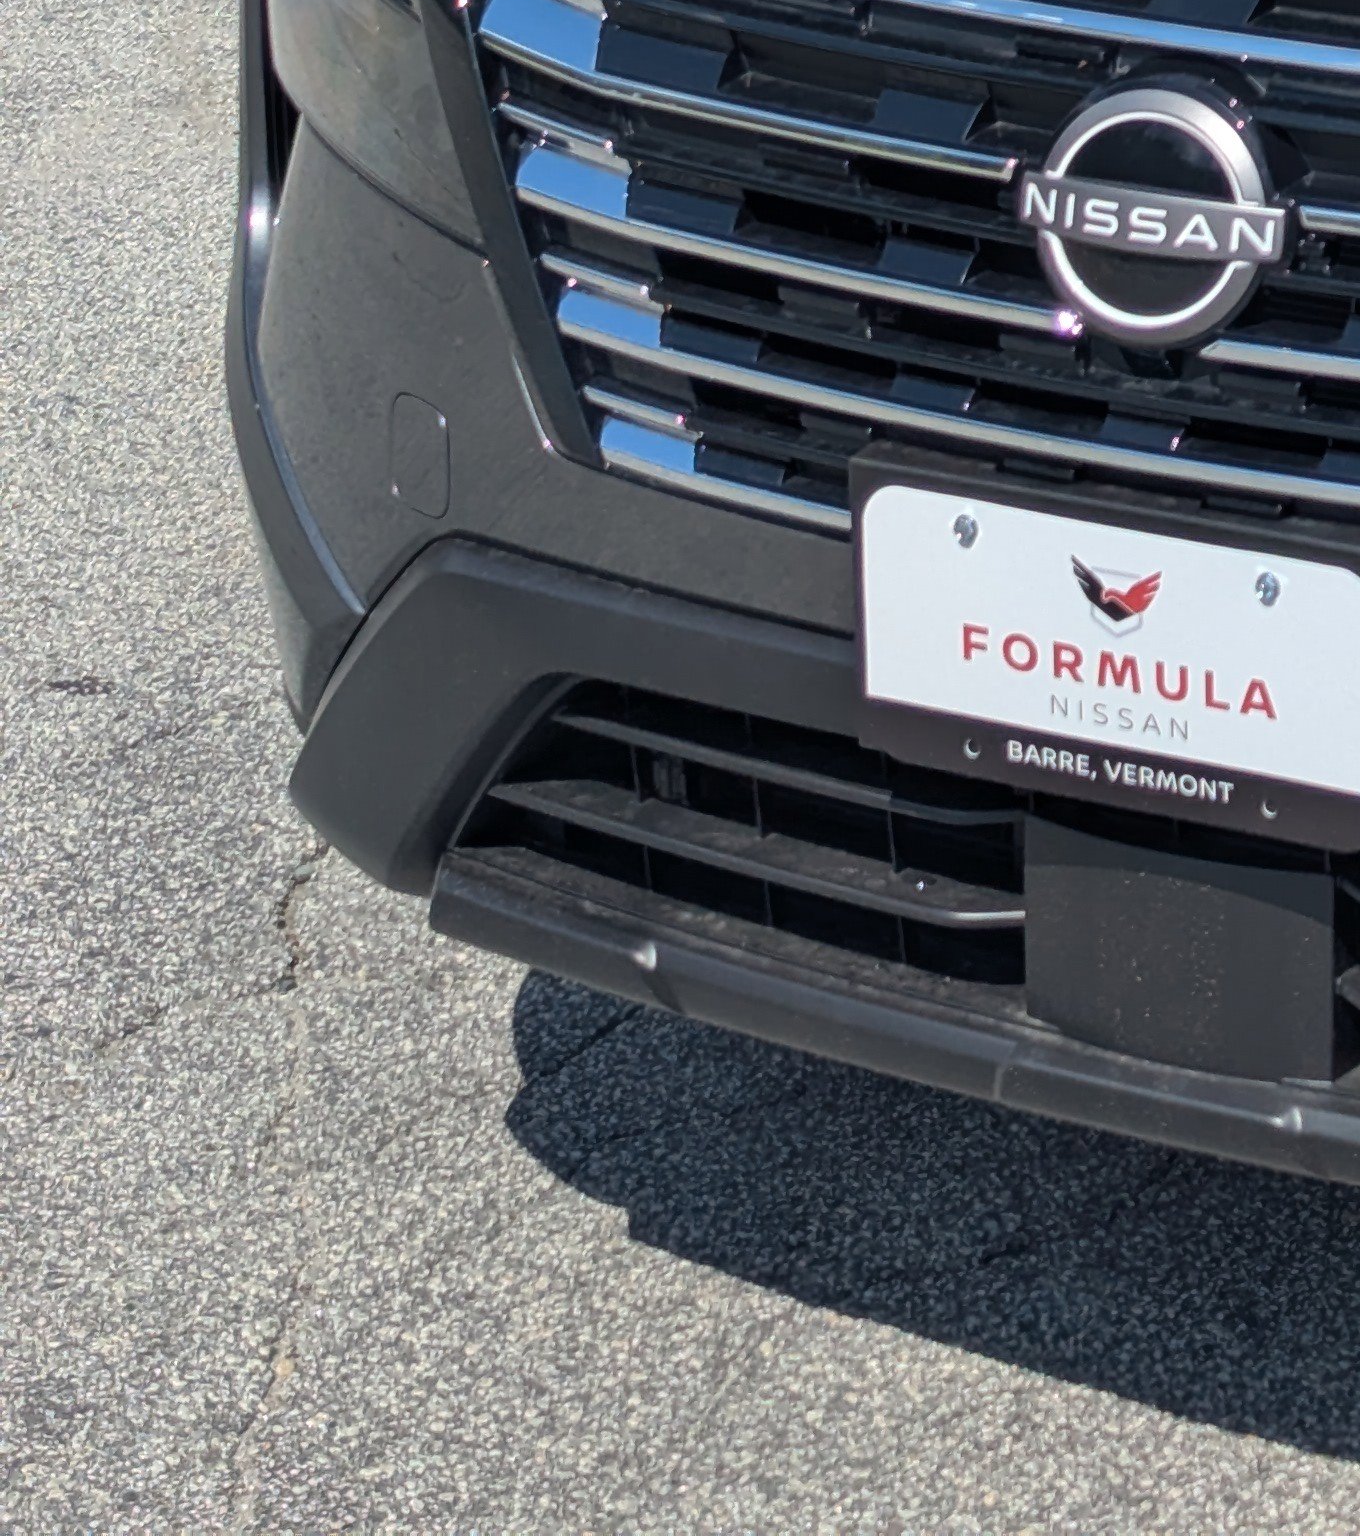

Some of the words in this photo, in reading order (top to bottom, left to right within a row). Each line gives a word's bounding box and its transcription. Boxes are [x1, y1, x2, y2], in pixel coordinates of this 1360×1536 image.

[1020, 182, 1277, 256] NISSAN
[962, 622, 1278, 721] FORMULA
[1050, 693, 1190, 742] NISSAN
[1005, 739, 1097, 782] BARRE,
[1102, 758, 1236, 805] VERMONT
